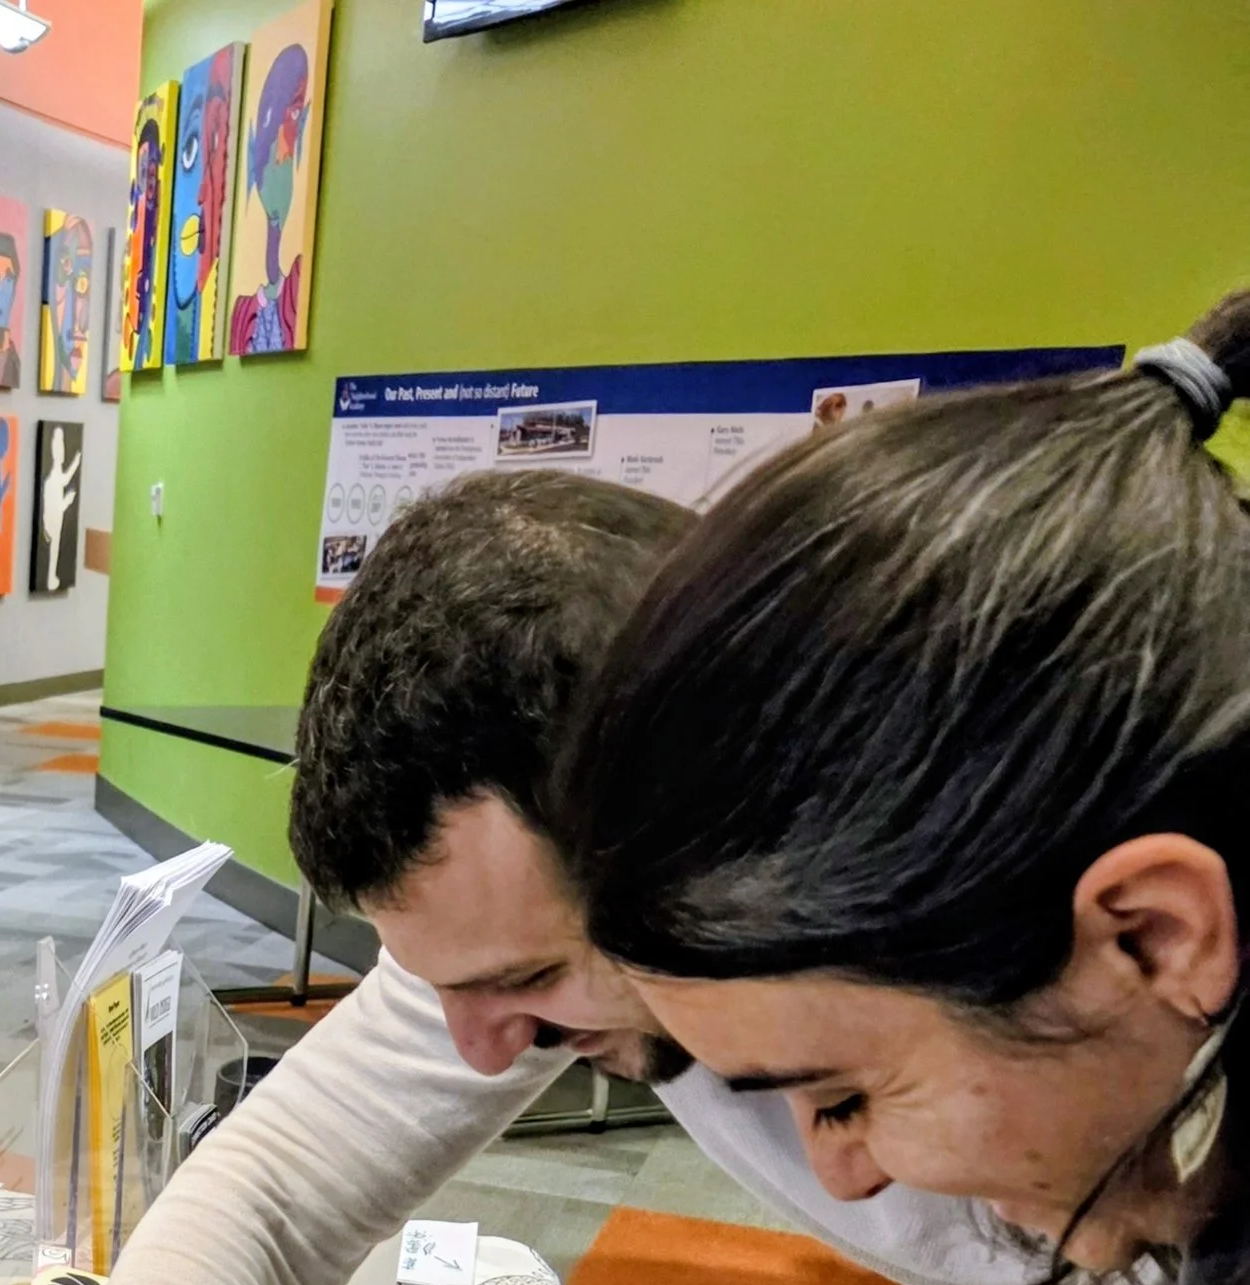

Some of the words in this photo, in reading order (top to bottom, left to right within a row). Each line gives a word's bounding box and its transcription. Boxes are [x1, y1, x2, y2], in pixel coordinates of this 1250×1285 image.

[415, 386, 443, 400] Present
[444, 384, 459, 400] and
[511, 382, 539, 398] Future
